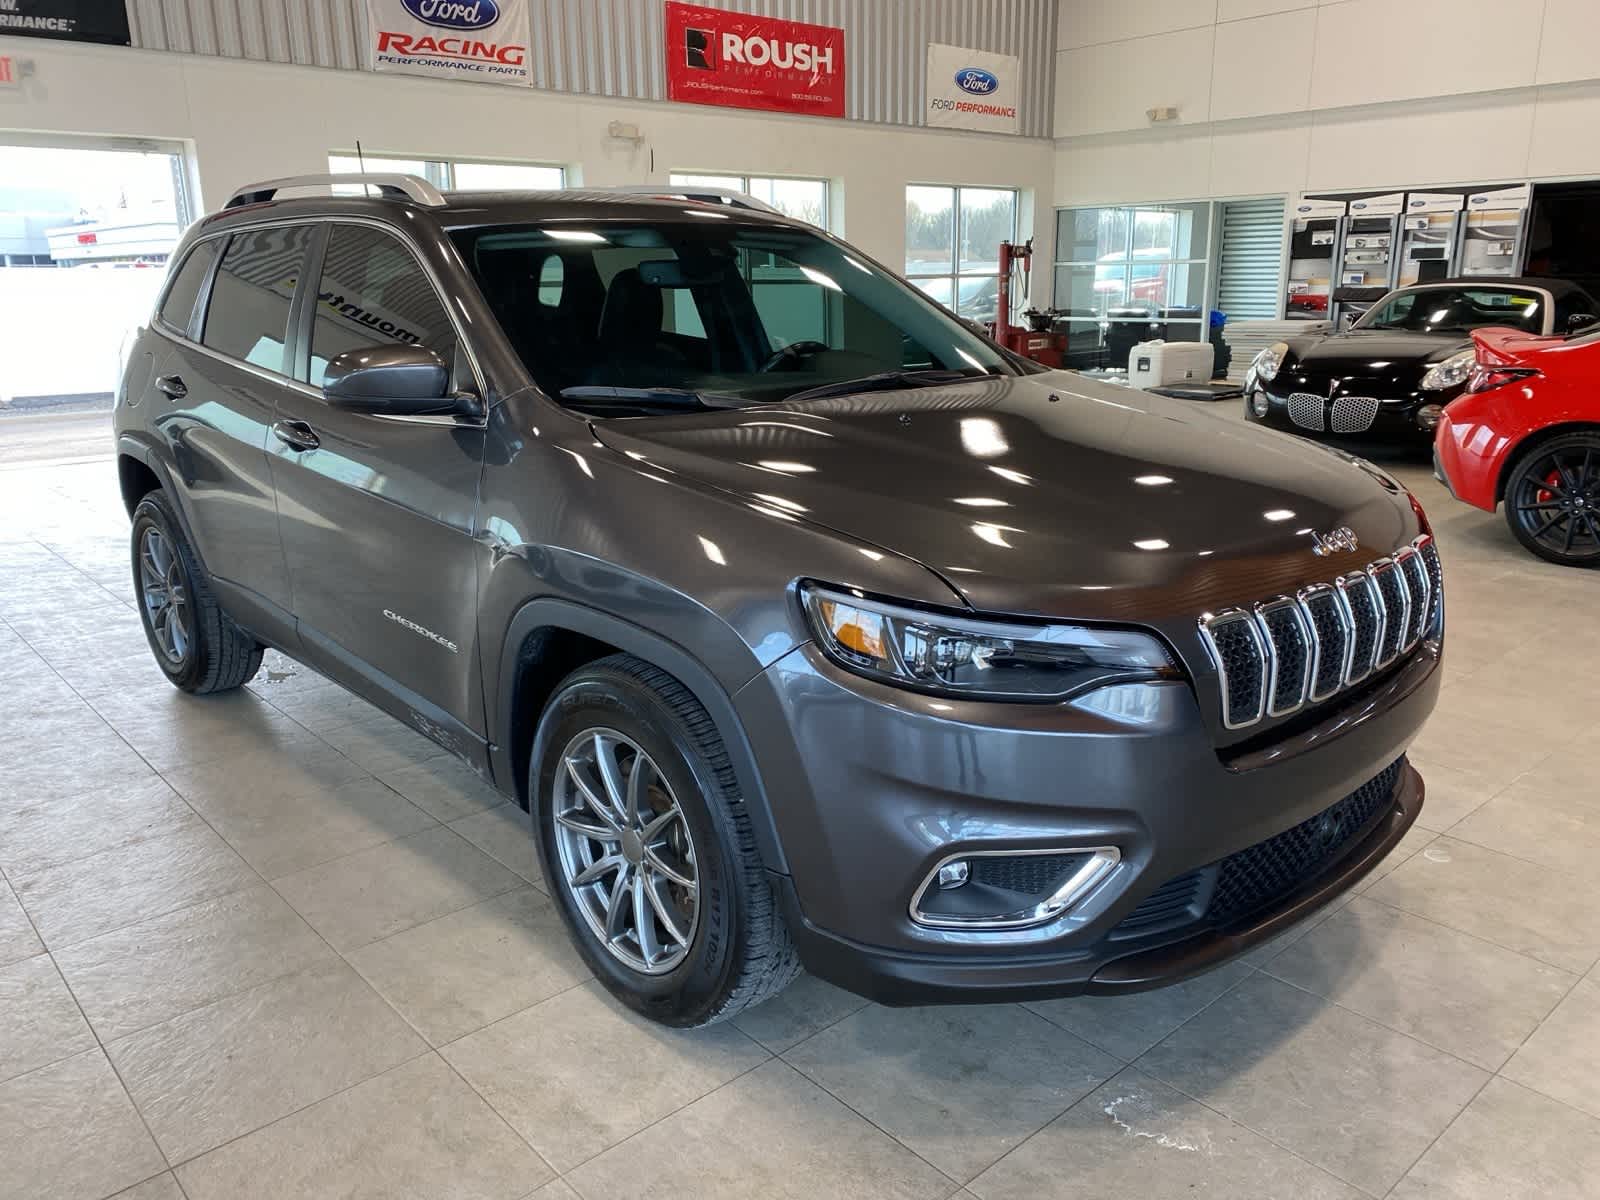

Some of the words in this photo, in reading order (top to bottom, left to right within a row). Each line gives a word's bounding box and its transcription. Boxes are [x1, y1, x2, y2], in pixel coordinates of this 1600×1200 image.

[420, 0, 481, 23] Ford
[378, 32, 526, 65] RACING
[722, 32, 833, 74] ROUSH
[378, 55, 485, 72] PERFORMANCE
[488, 66, 527, 76] PARTS
[963, 71, 990, 91] Ford
[931, 99, 955, 111] FORD
[955, 101, 1017, 118] PERFORMANCE
[1311, 526, 1359, 557] Jeep
[383, 609, 458, 654] CHEROKEE
